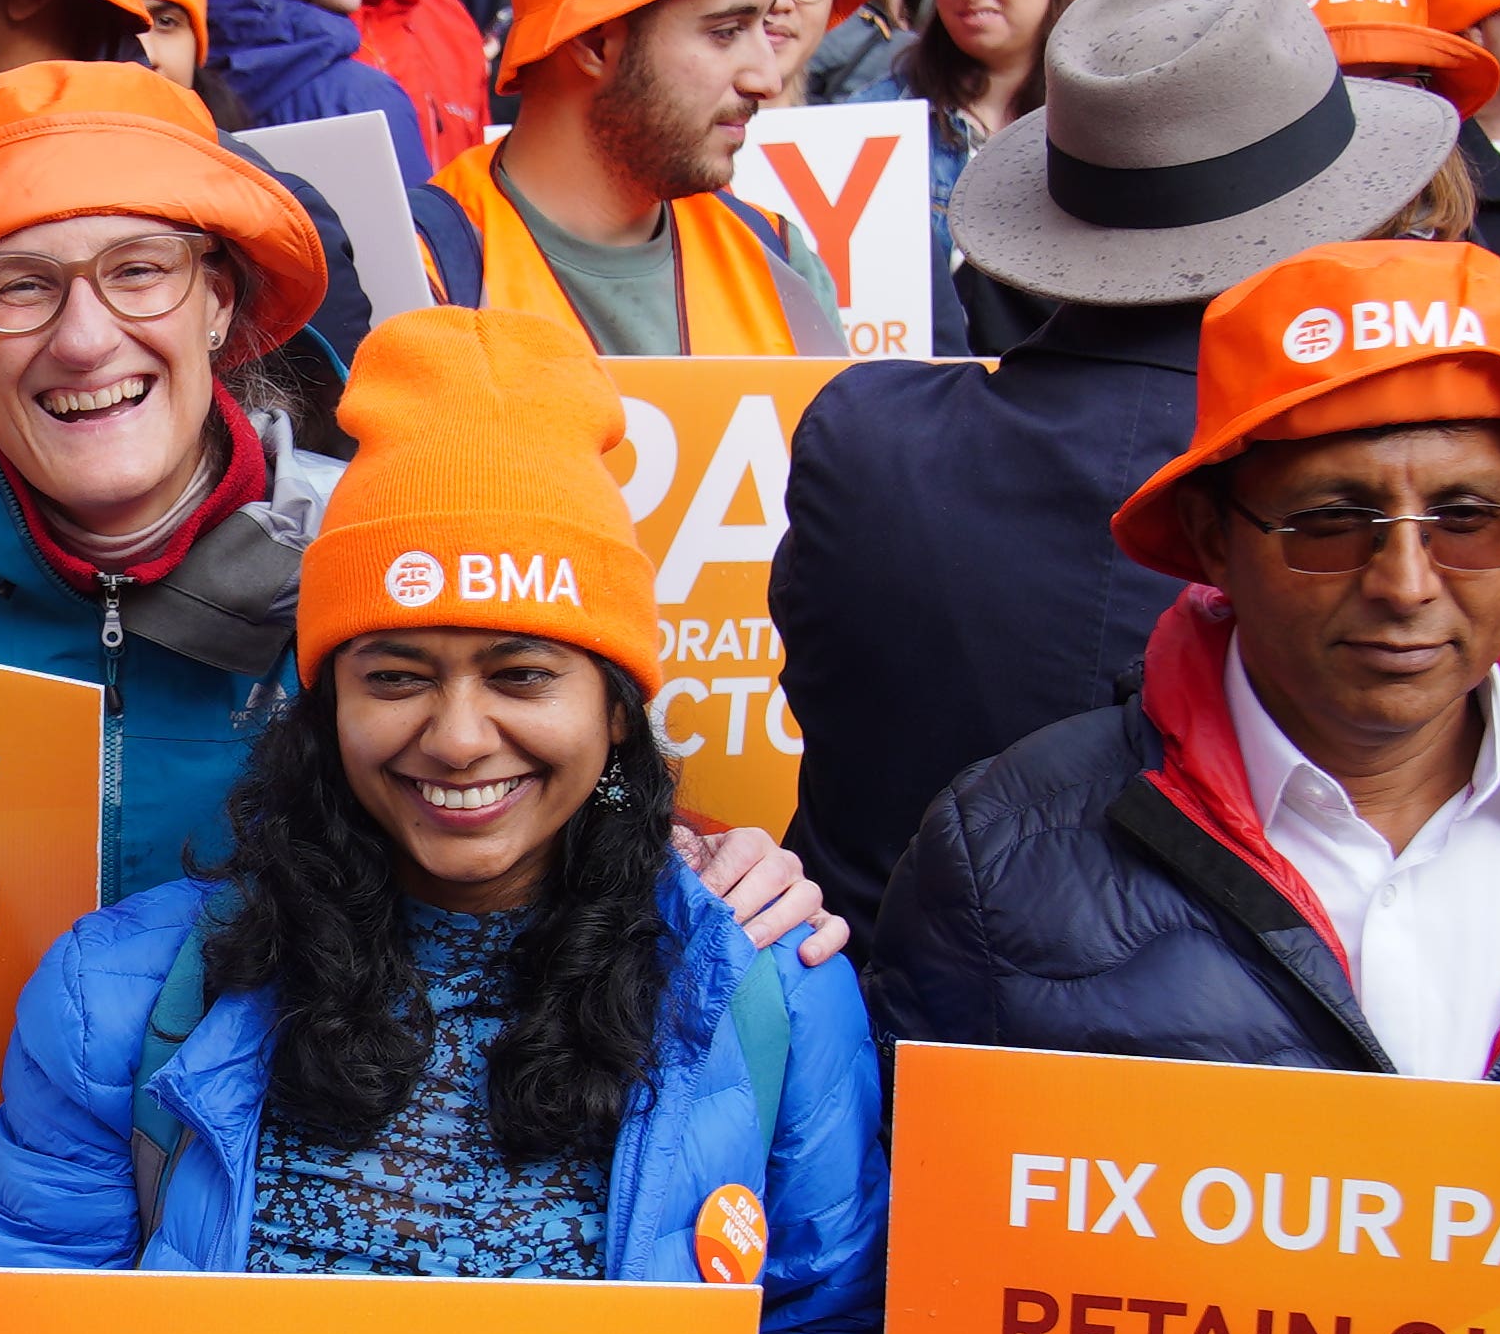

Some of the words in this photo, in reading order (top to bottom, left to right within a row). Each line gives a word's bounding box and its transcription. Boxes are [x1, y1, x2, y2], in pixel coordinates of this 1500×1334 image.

[841, 321, 909, 357] OR
[1352, 300, 1487, 350] BMA
[458, 552, 581, 607] BMA
[716, 1195, 764, 1252] RESTORATION
[735, 1195, 760, 1225] PAY
[1009, 1153, 1158, 1238] FIX
[1181, 1167, 1404, 1258] OUR
[721, 1218, 752, 1256] NOW
